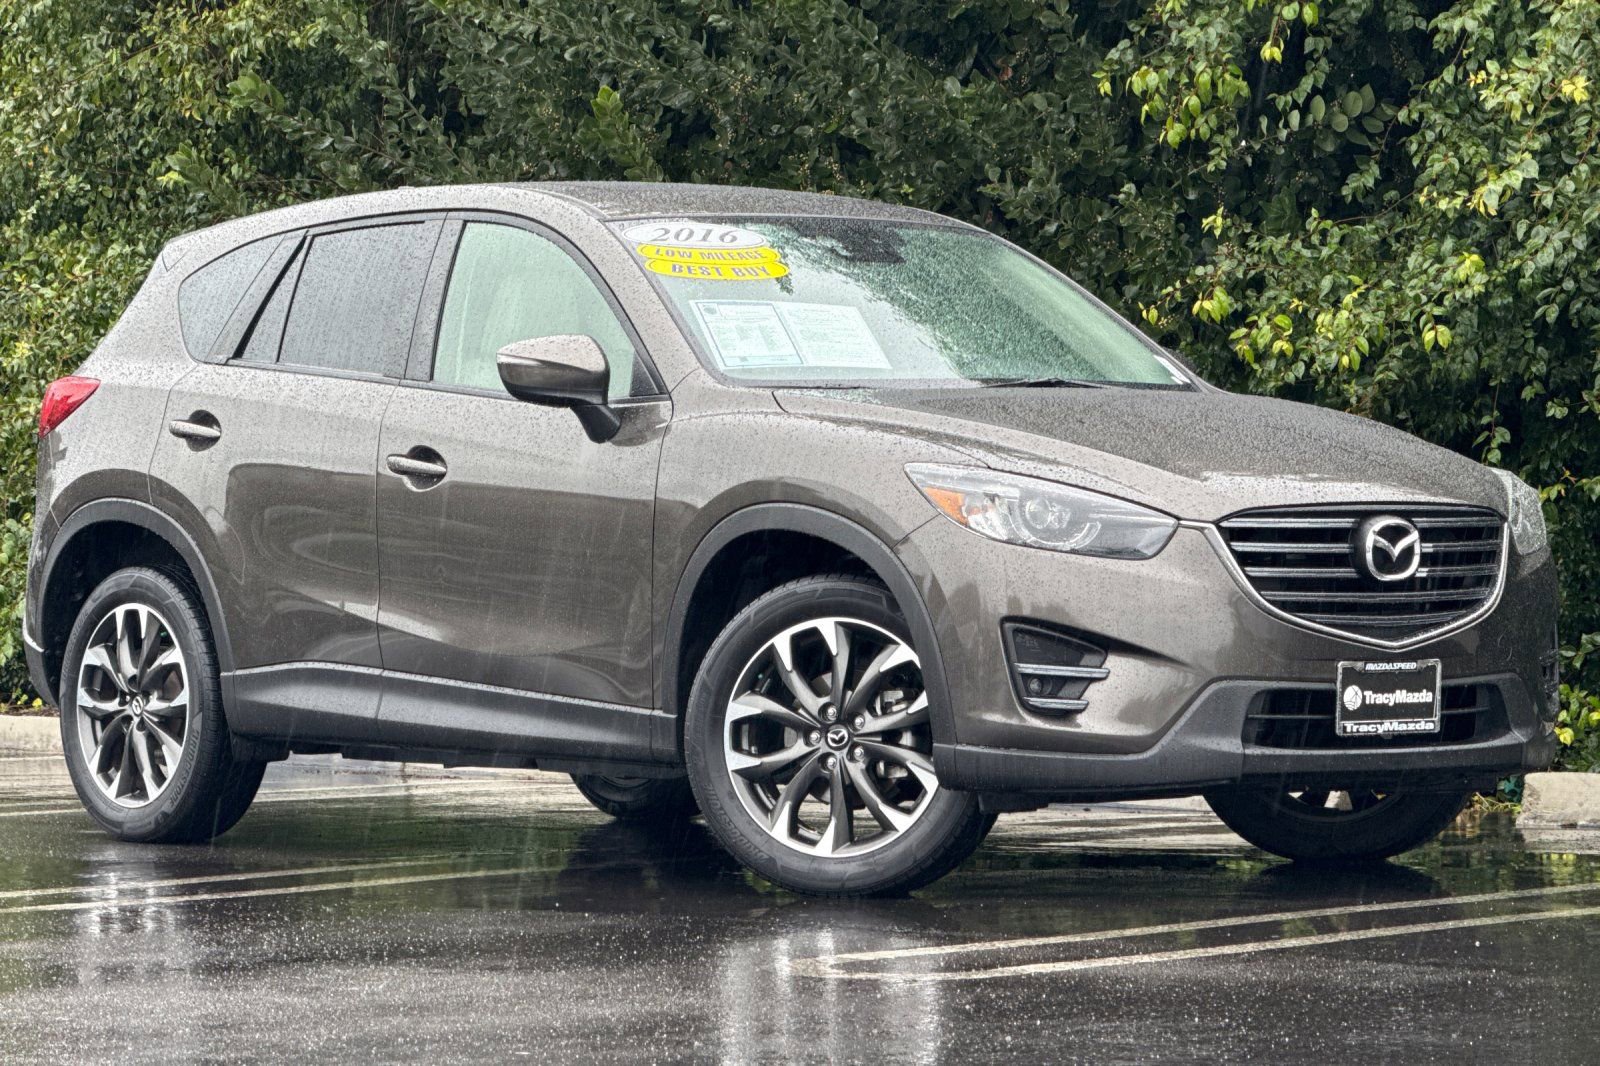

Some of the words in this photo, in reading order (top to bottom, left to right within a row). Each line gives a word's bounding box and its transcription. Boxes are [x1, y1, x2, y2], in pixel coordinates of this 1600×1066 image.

[650, 227, 738, 244] 2016
[655, 248, 693, 259] LOW
[699, 247, 768, 261] MILEAGE
[671, 263, 723, 277] BEST
[732, 265, 771, 277] BUY
[1365, 662, 1417, 671] MAZDASPEED
[1363, 688, 1433, 707] TracyMazda
[1343, 721, 1435, 733] TracyMazda
